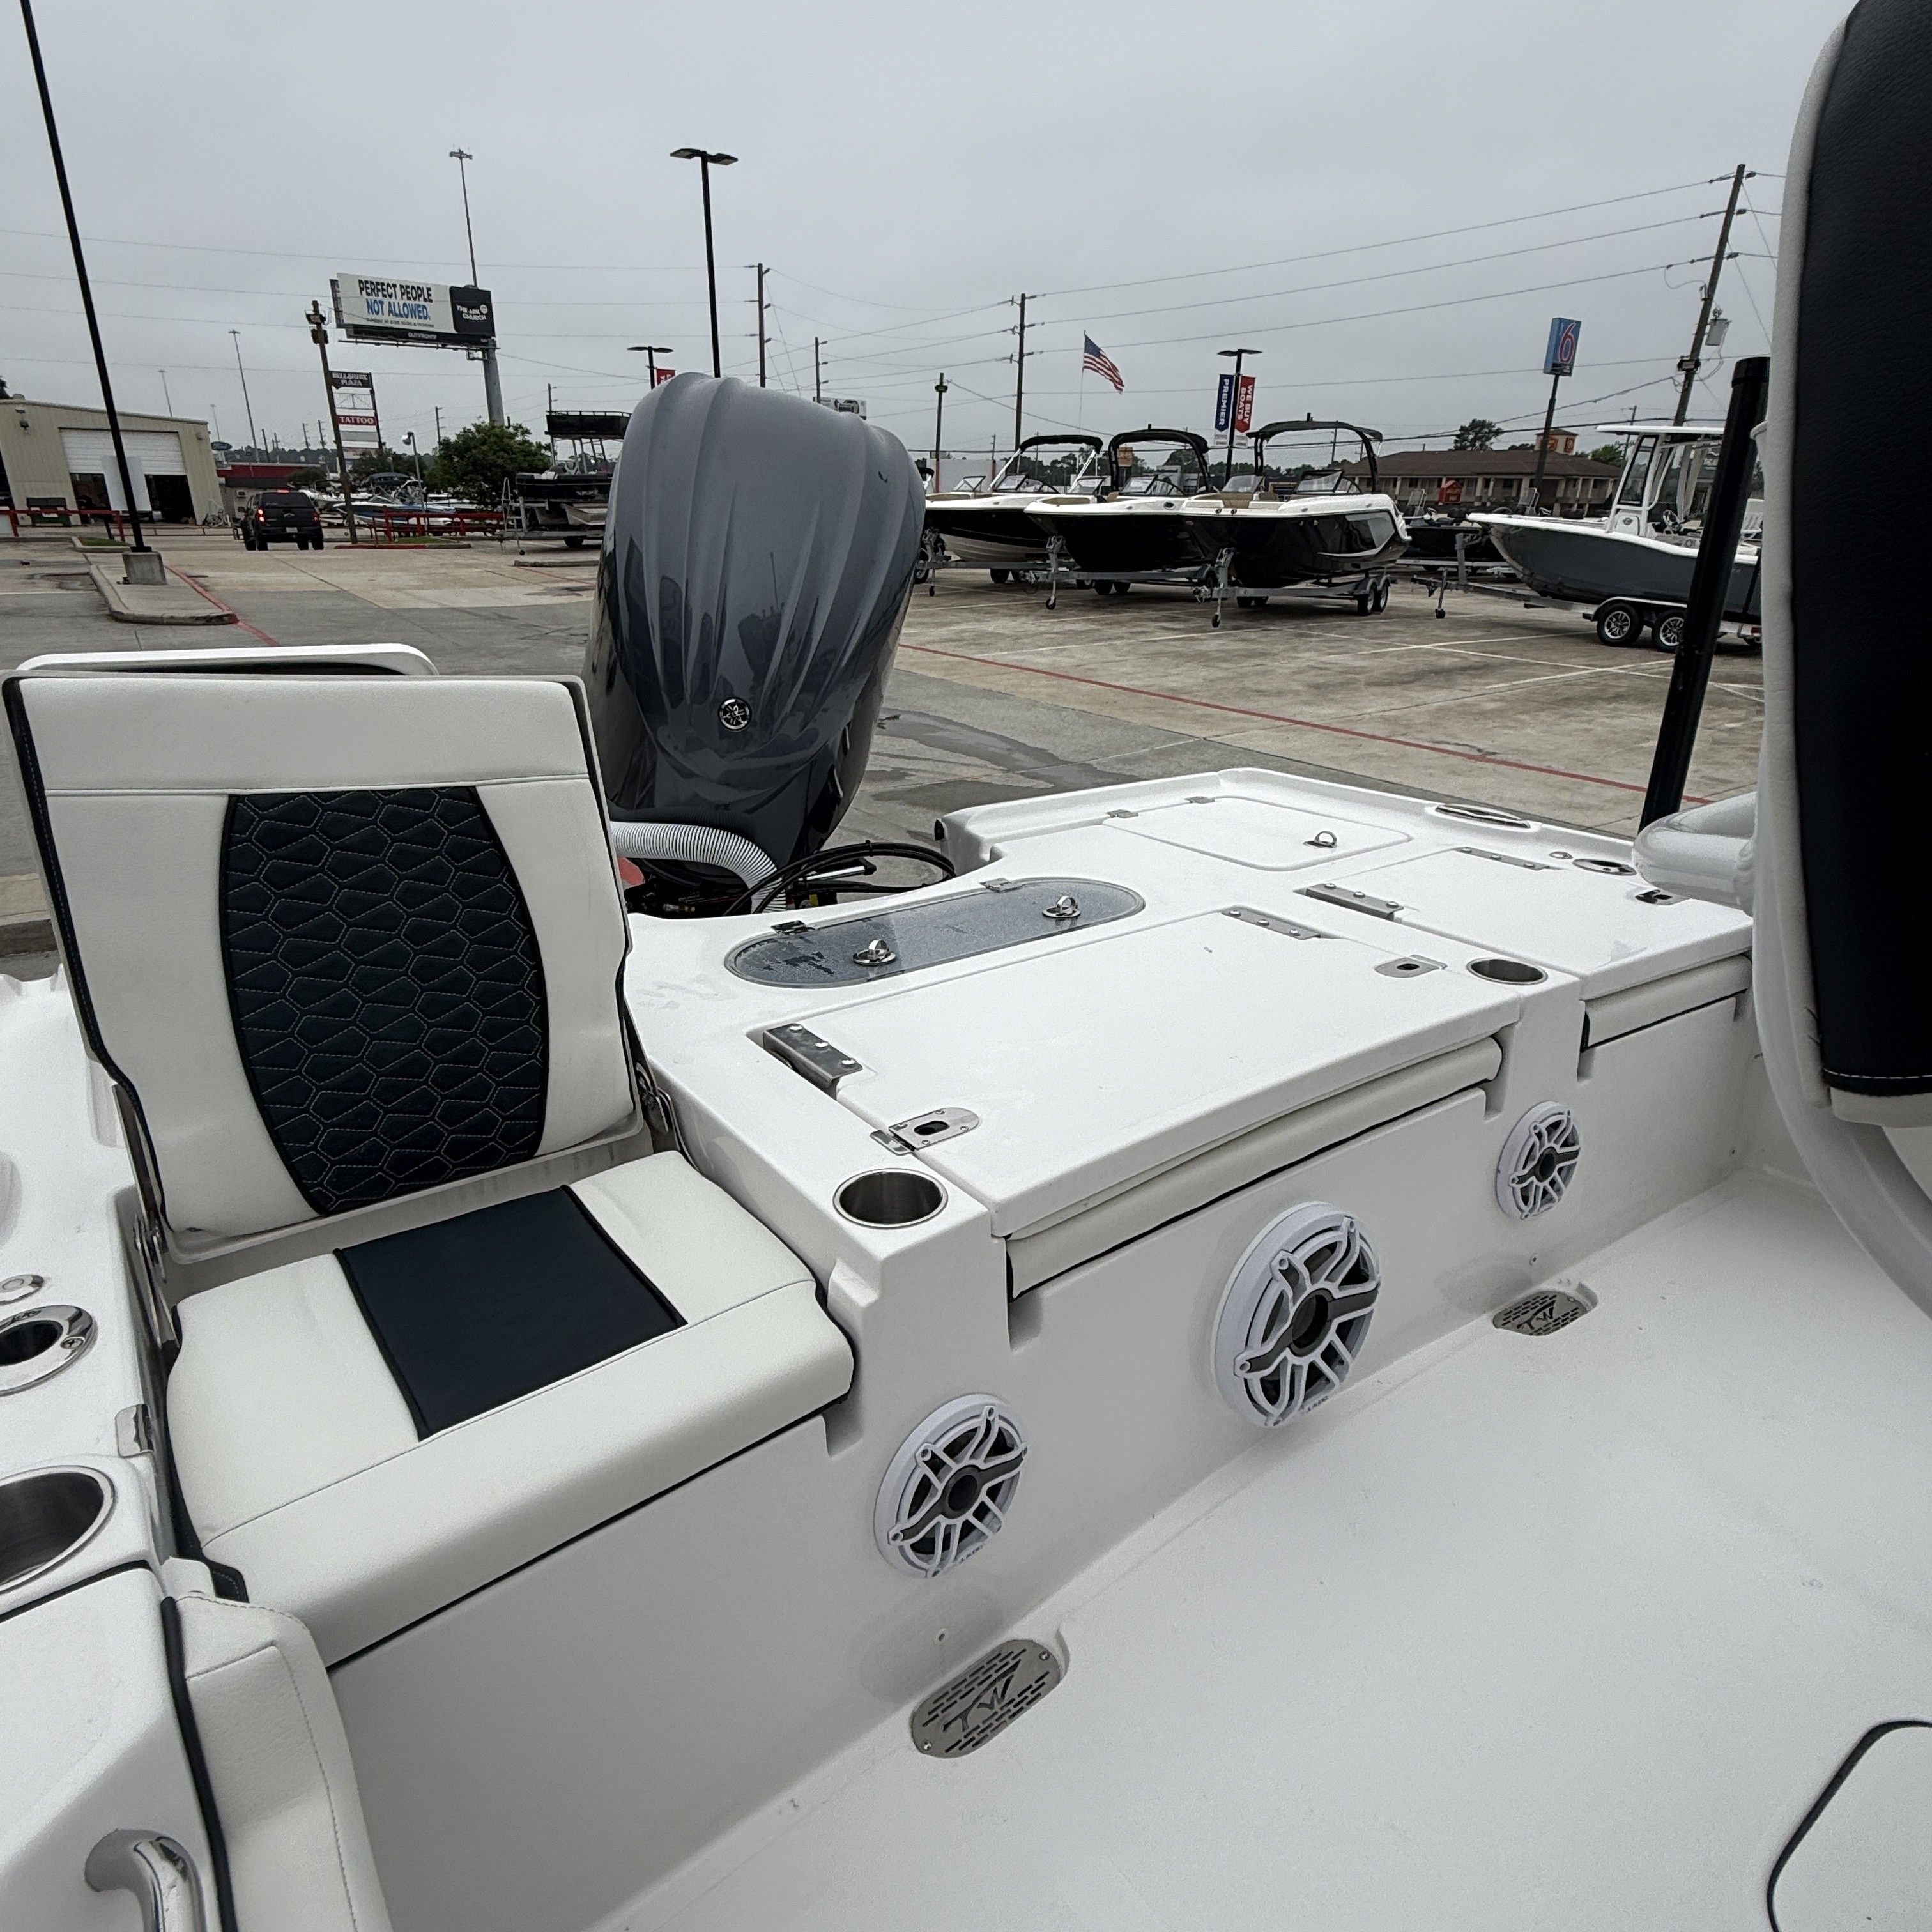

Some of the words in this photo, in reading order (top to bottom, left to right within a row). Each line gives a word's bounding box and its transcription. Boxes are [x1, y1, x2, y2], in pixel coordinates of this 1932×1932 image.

[358, 279, 397, 300] PERFECT
[399, 284, 433, 303] PEOPLE
[366, 298, 384, 316] NOT
[388, 301, 431, 320] ALLOWED.
[1558, 322, 1576, 364] 6
[1218, 378, 1229, 425] PREMIER
[1238, 387, 1246, 420] BOATS
[1246, 385, 1253, 401] WE
